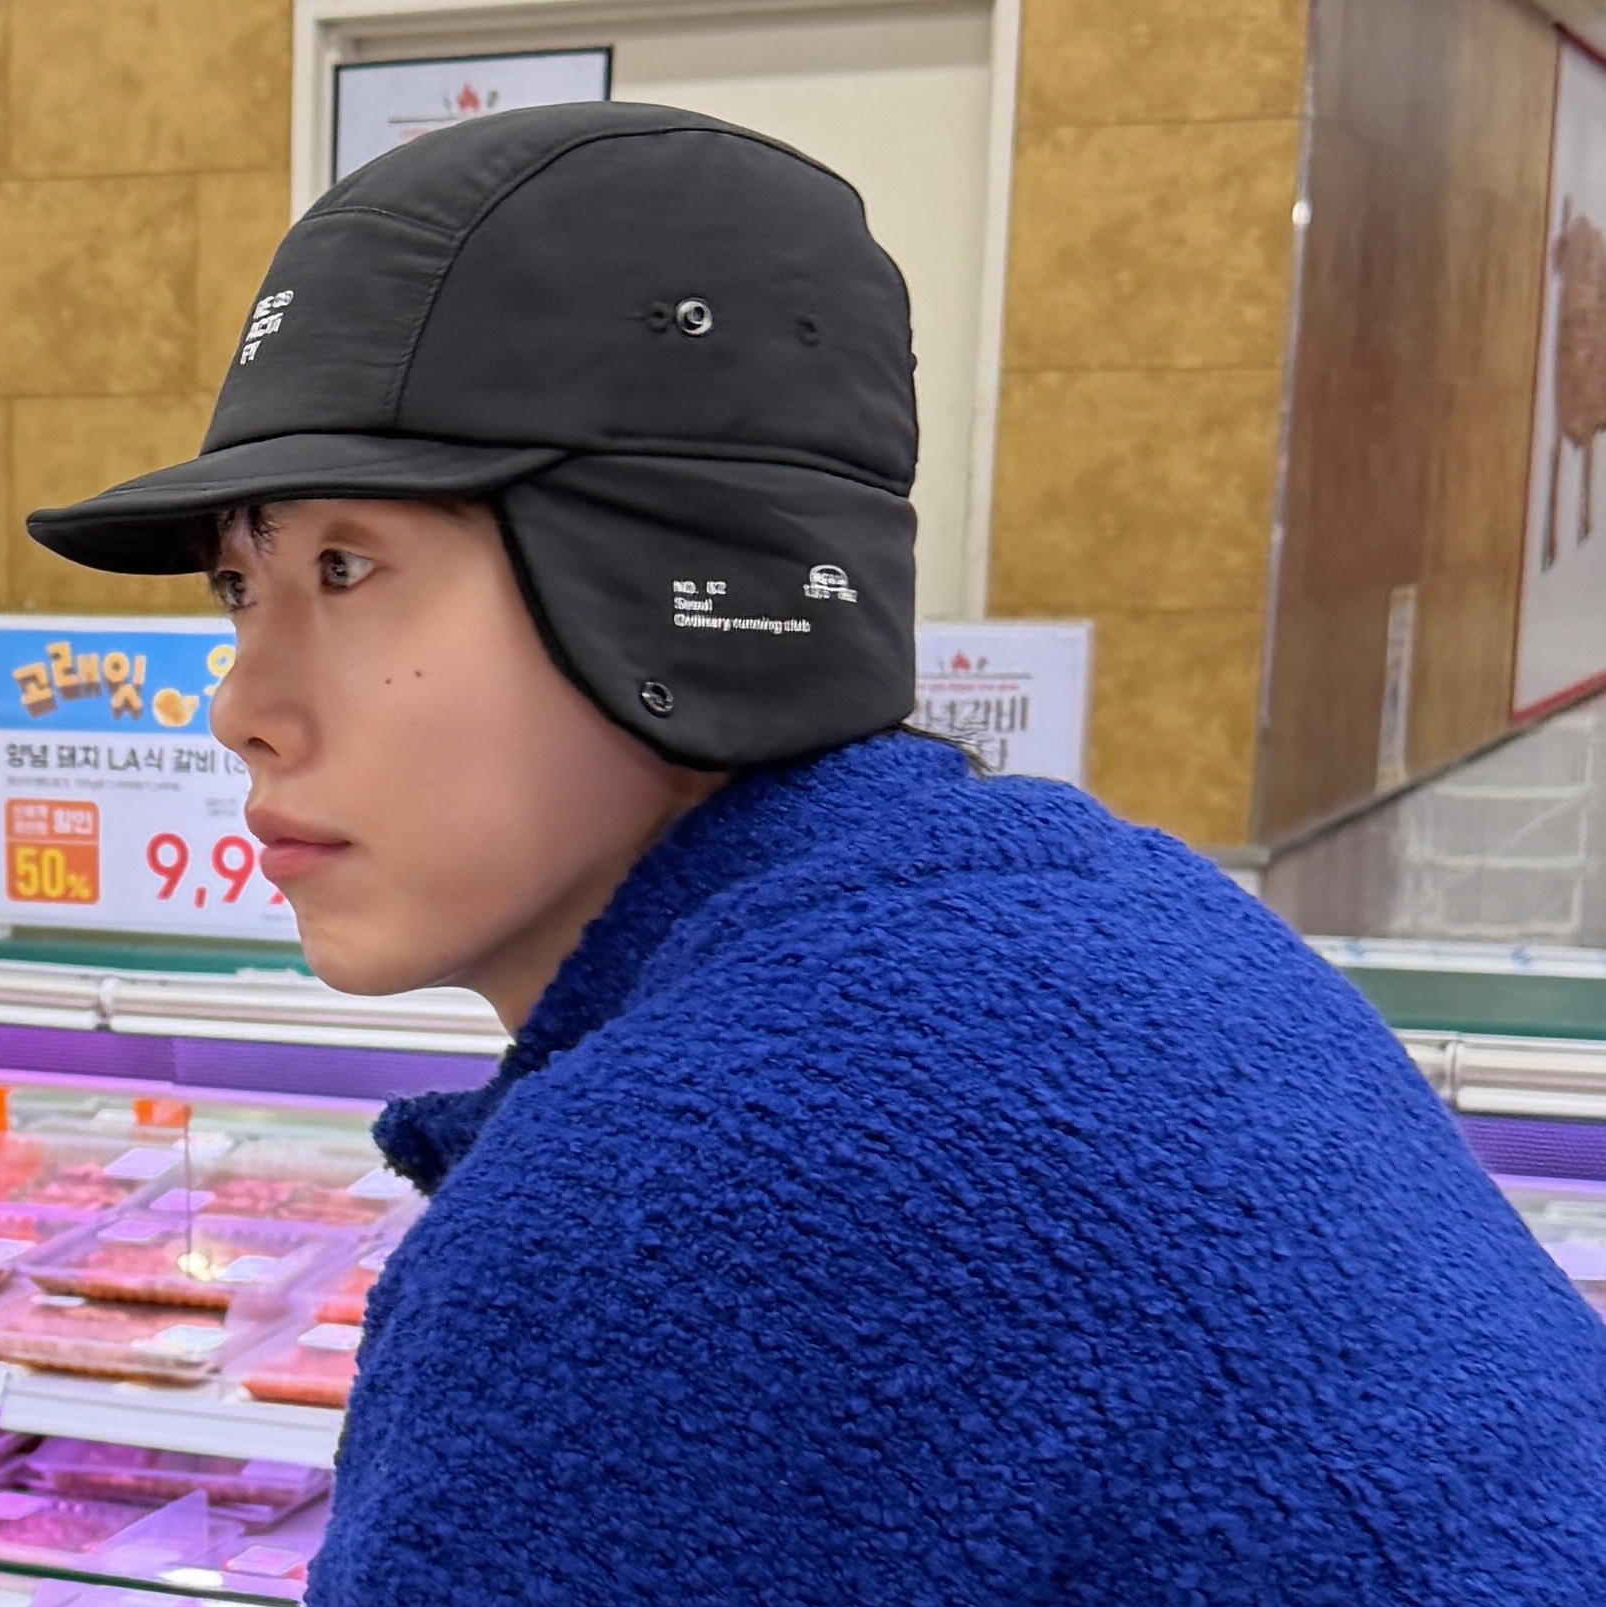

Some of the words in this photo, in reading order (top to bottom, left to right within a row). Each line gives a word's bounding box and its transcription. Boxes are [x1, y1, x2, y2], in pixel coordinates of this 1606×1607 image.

[11, 641, 147, 721] 고래잇
[4, 742, 50, 769] 양념
[56, 744, 101, 770] 돼지
[106, 746, 164, 773] LA식
[172, 748, 217, 775] 갈비
[14, 846, 92, 900] 50%
[145, 832, 286, 908] 9,9
